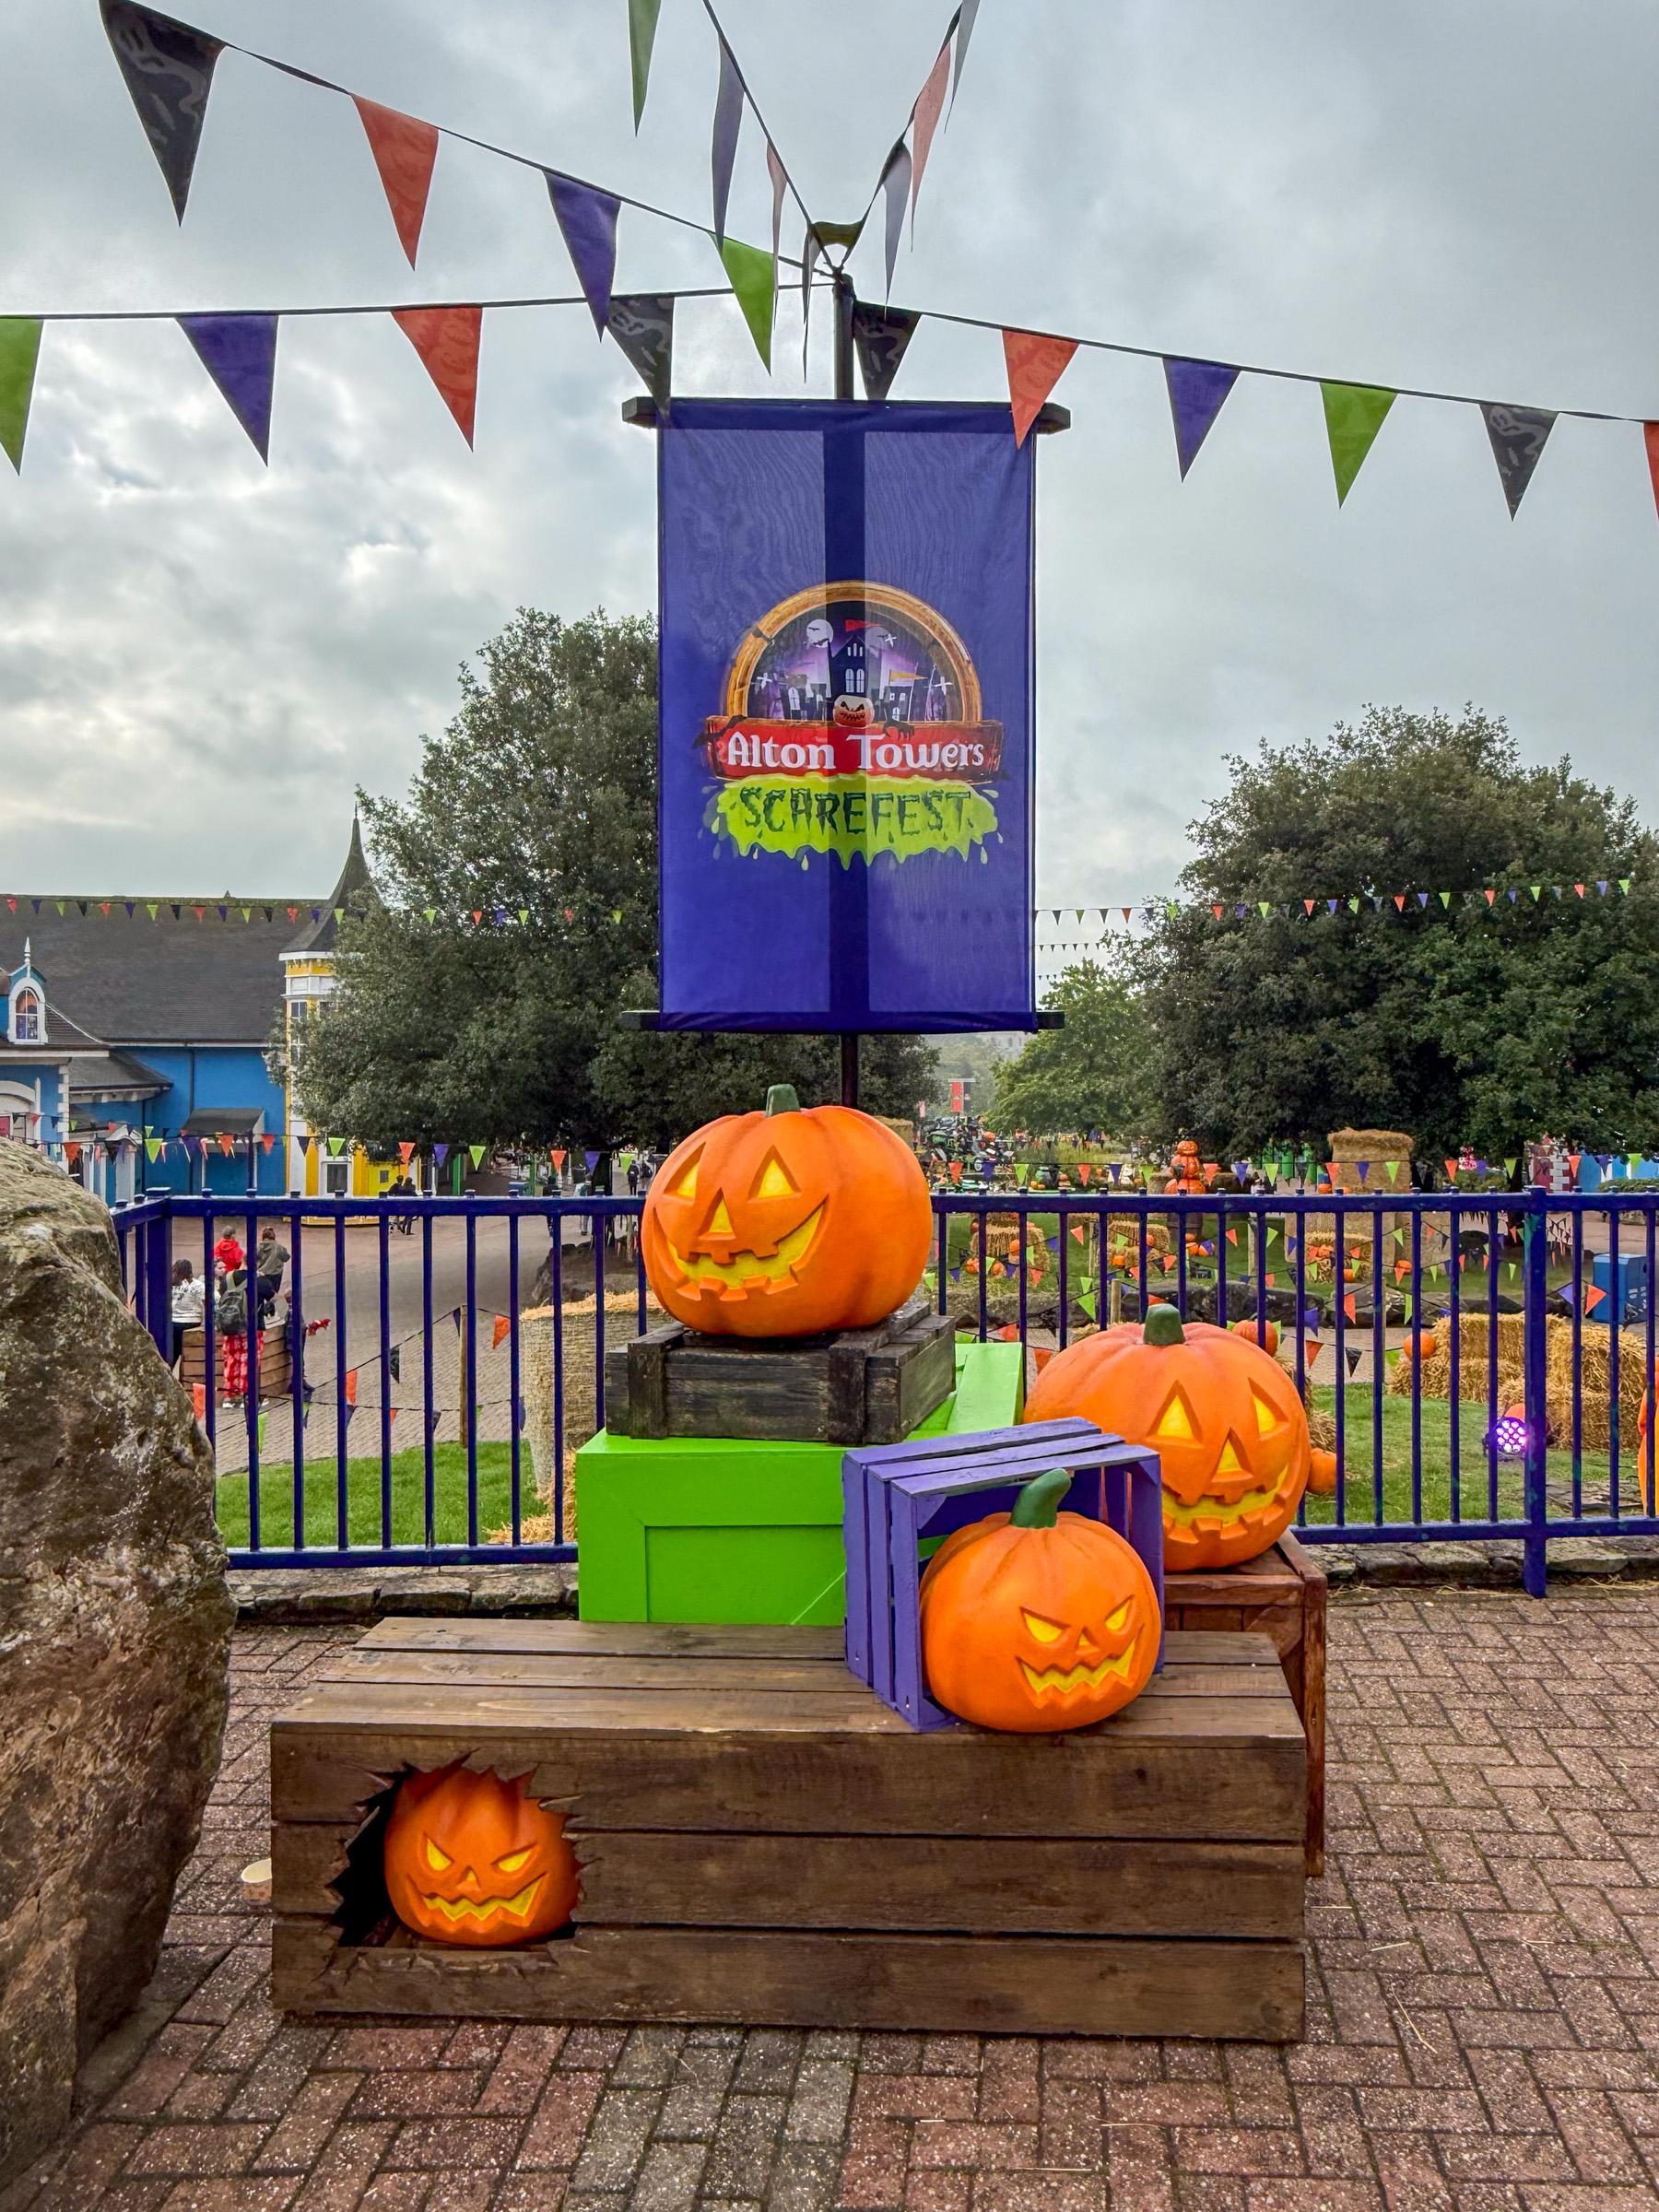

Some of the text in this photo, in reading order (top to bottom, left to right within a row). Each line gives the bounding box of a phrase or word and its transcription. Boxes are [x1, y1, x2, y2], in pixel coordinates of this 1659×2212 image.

[727, 731, 984, 770] Alton Towers
[740, 786, 971, 836] SCAREFEST
